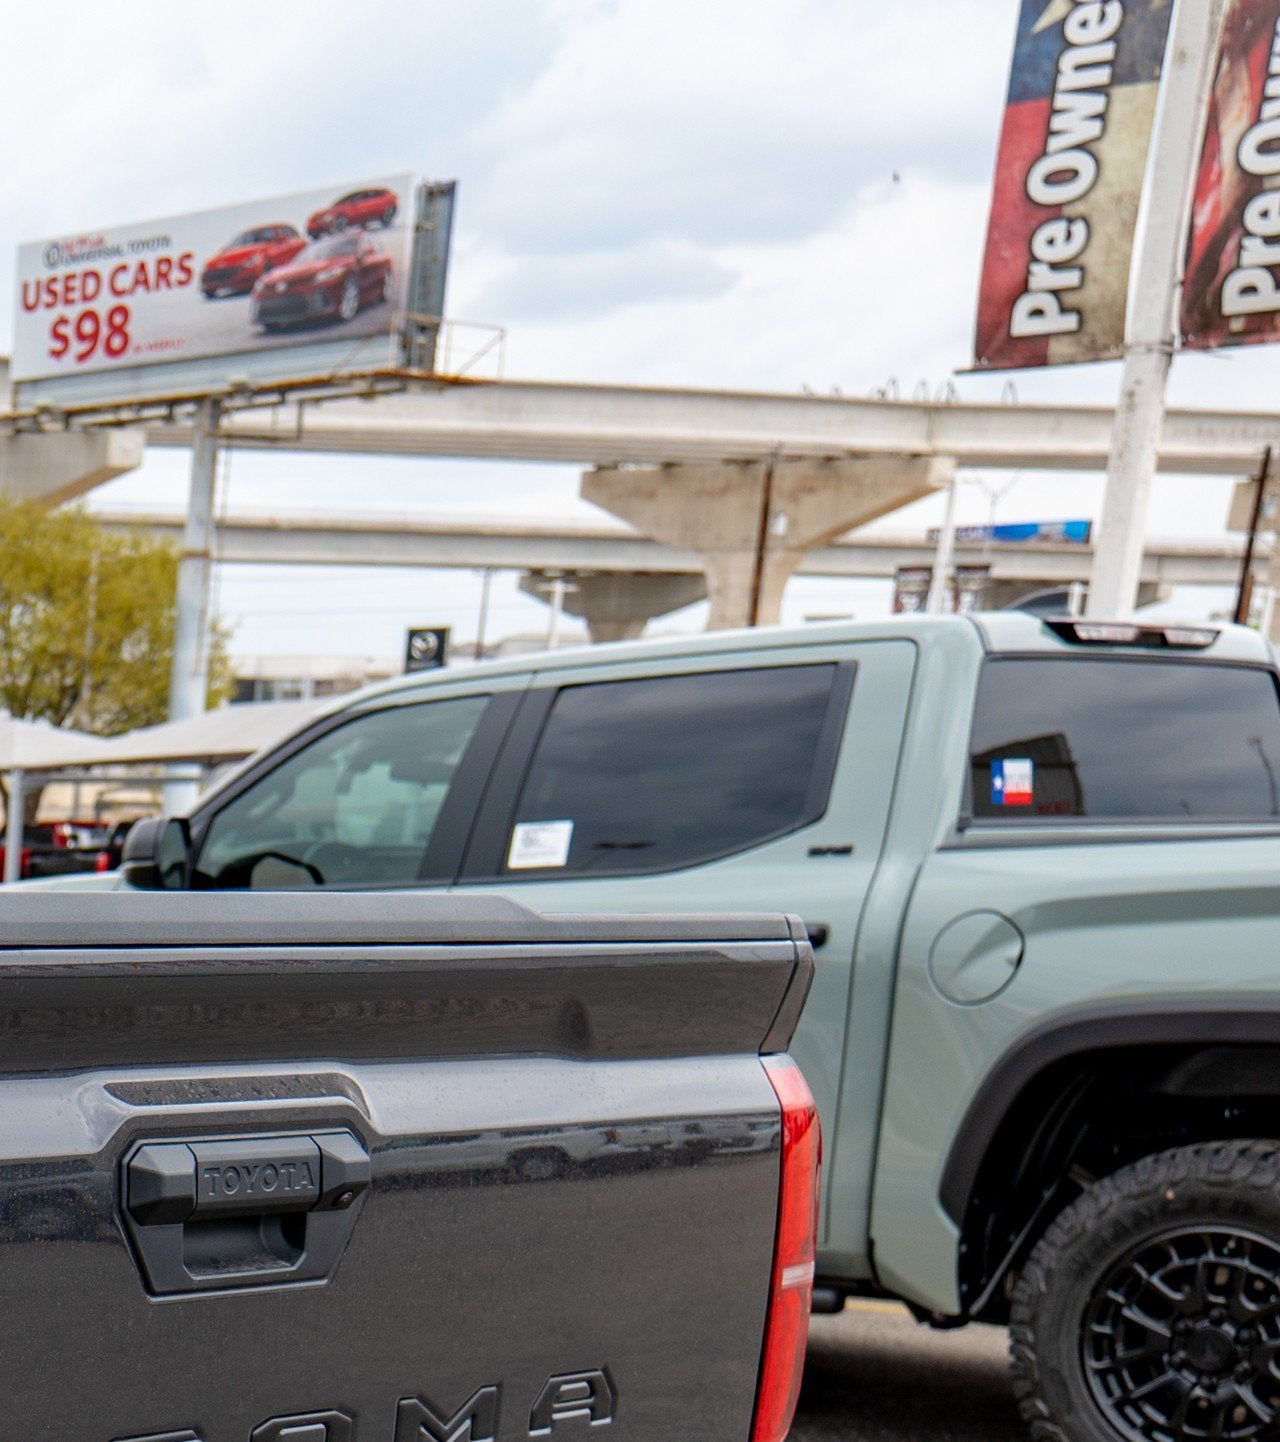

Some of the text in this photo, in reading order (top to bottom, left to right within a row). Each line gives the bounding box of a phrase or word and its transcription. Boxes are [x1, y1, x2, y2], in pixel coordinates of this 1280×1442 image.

[22, 270, 101, 311] USED
[109, 252, 193, 296] CARS
[1010, 217, 1088, 337] Pre
[48, 305, 130, 362] $98
[204, 1162, 315, 1195] TOYOTA
